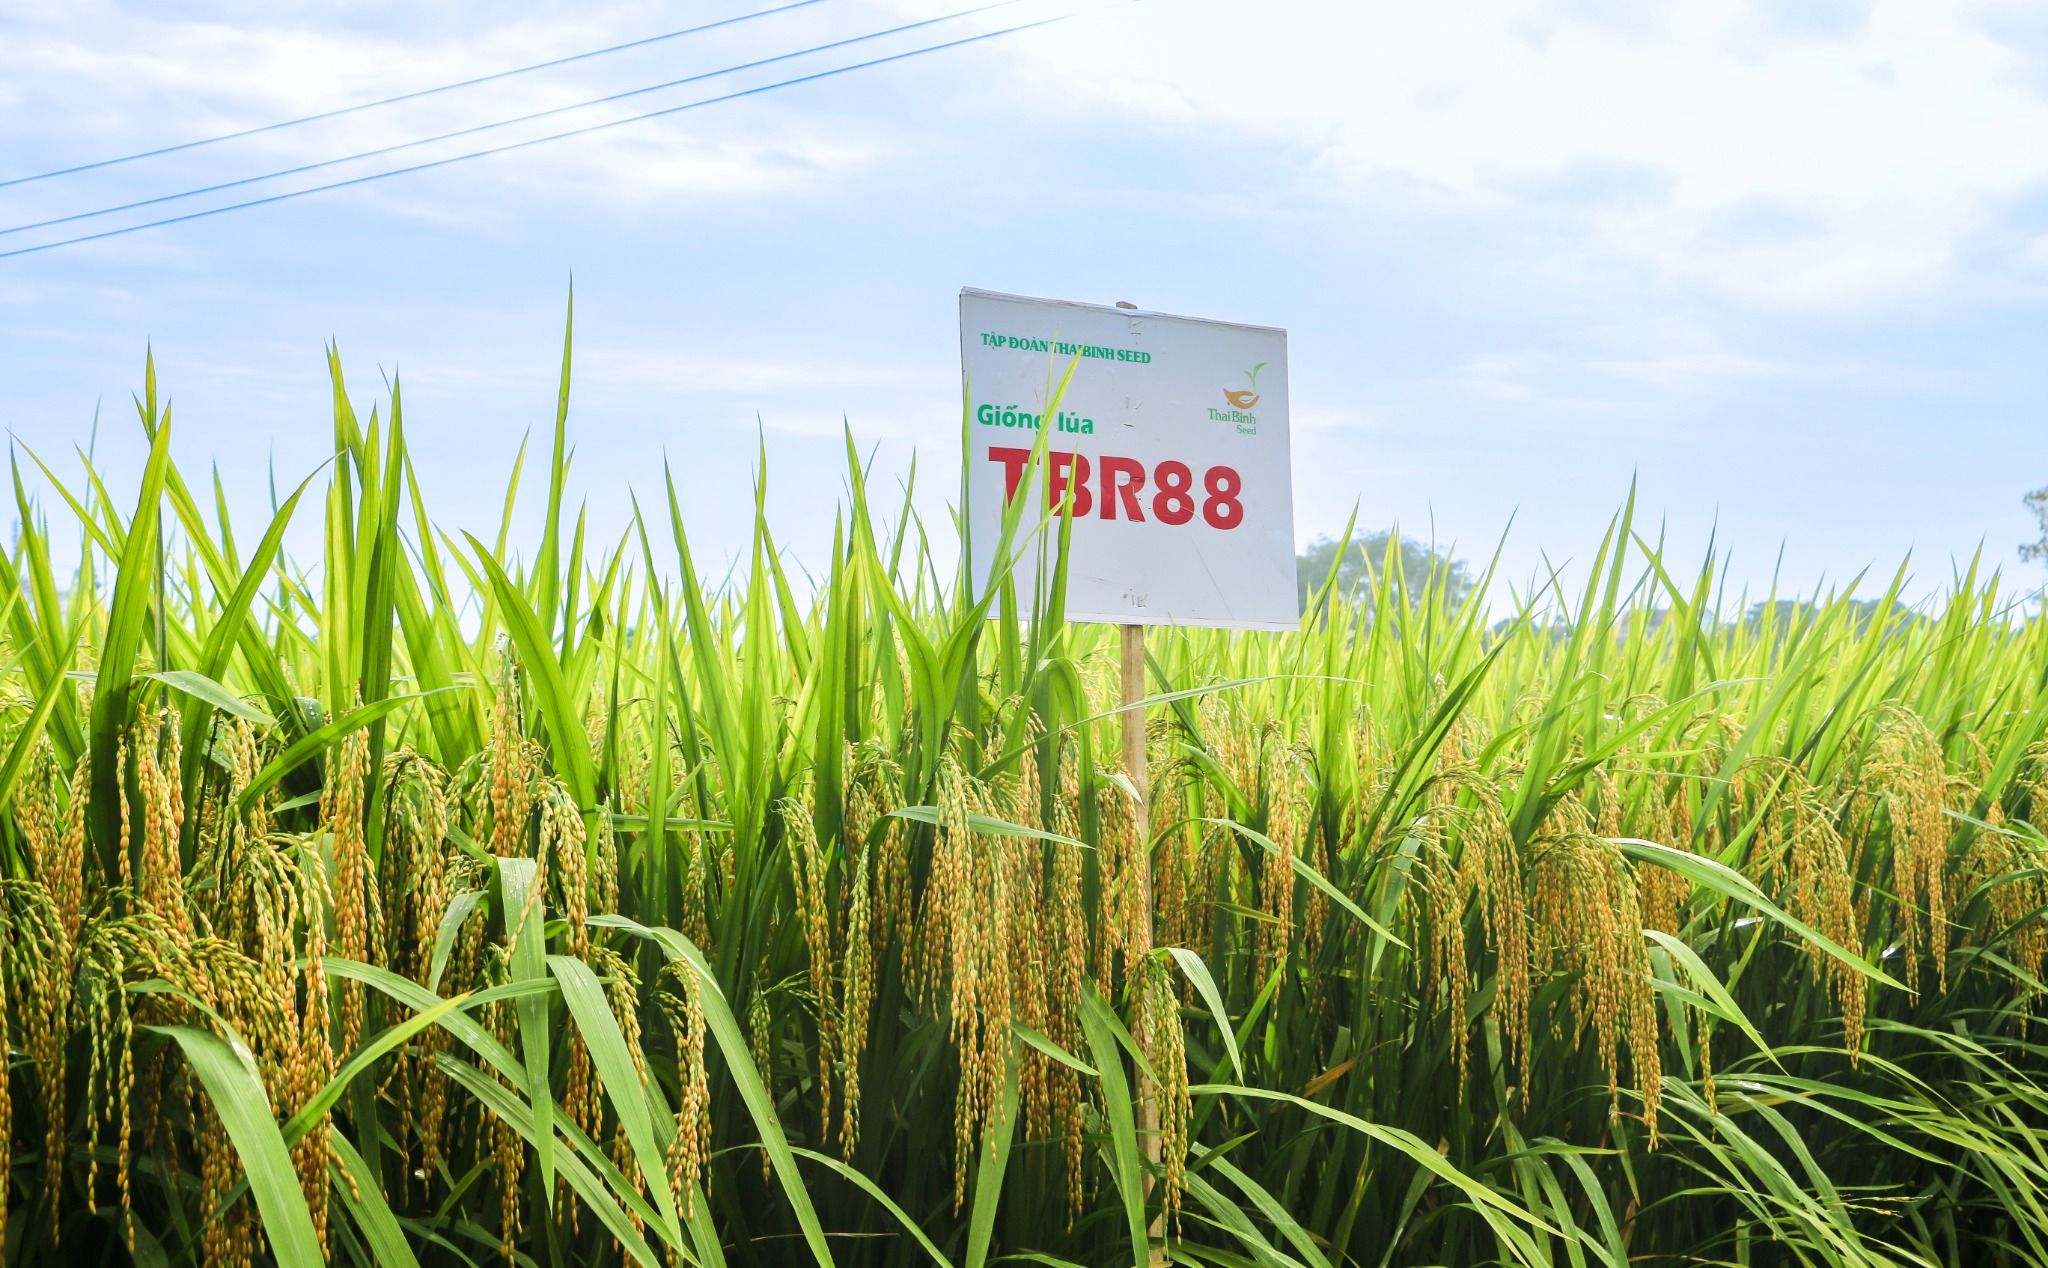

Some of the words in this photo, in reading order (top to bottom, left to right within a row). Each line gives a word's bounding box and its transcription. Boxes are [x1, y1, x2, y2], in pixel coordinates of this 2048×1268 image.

[981, 331, 1006, 350] TẬP
[1008, 336, 1048, 352] ĐOÀN
[1116, 348, 1151, 363] SEED
[1058, 411, 1094, 434] lúa
[1236, 424, 1256, 435] Seed
